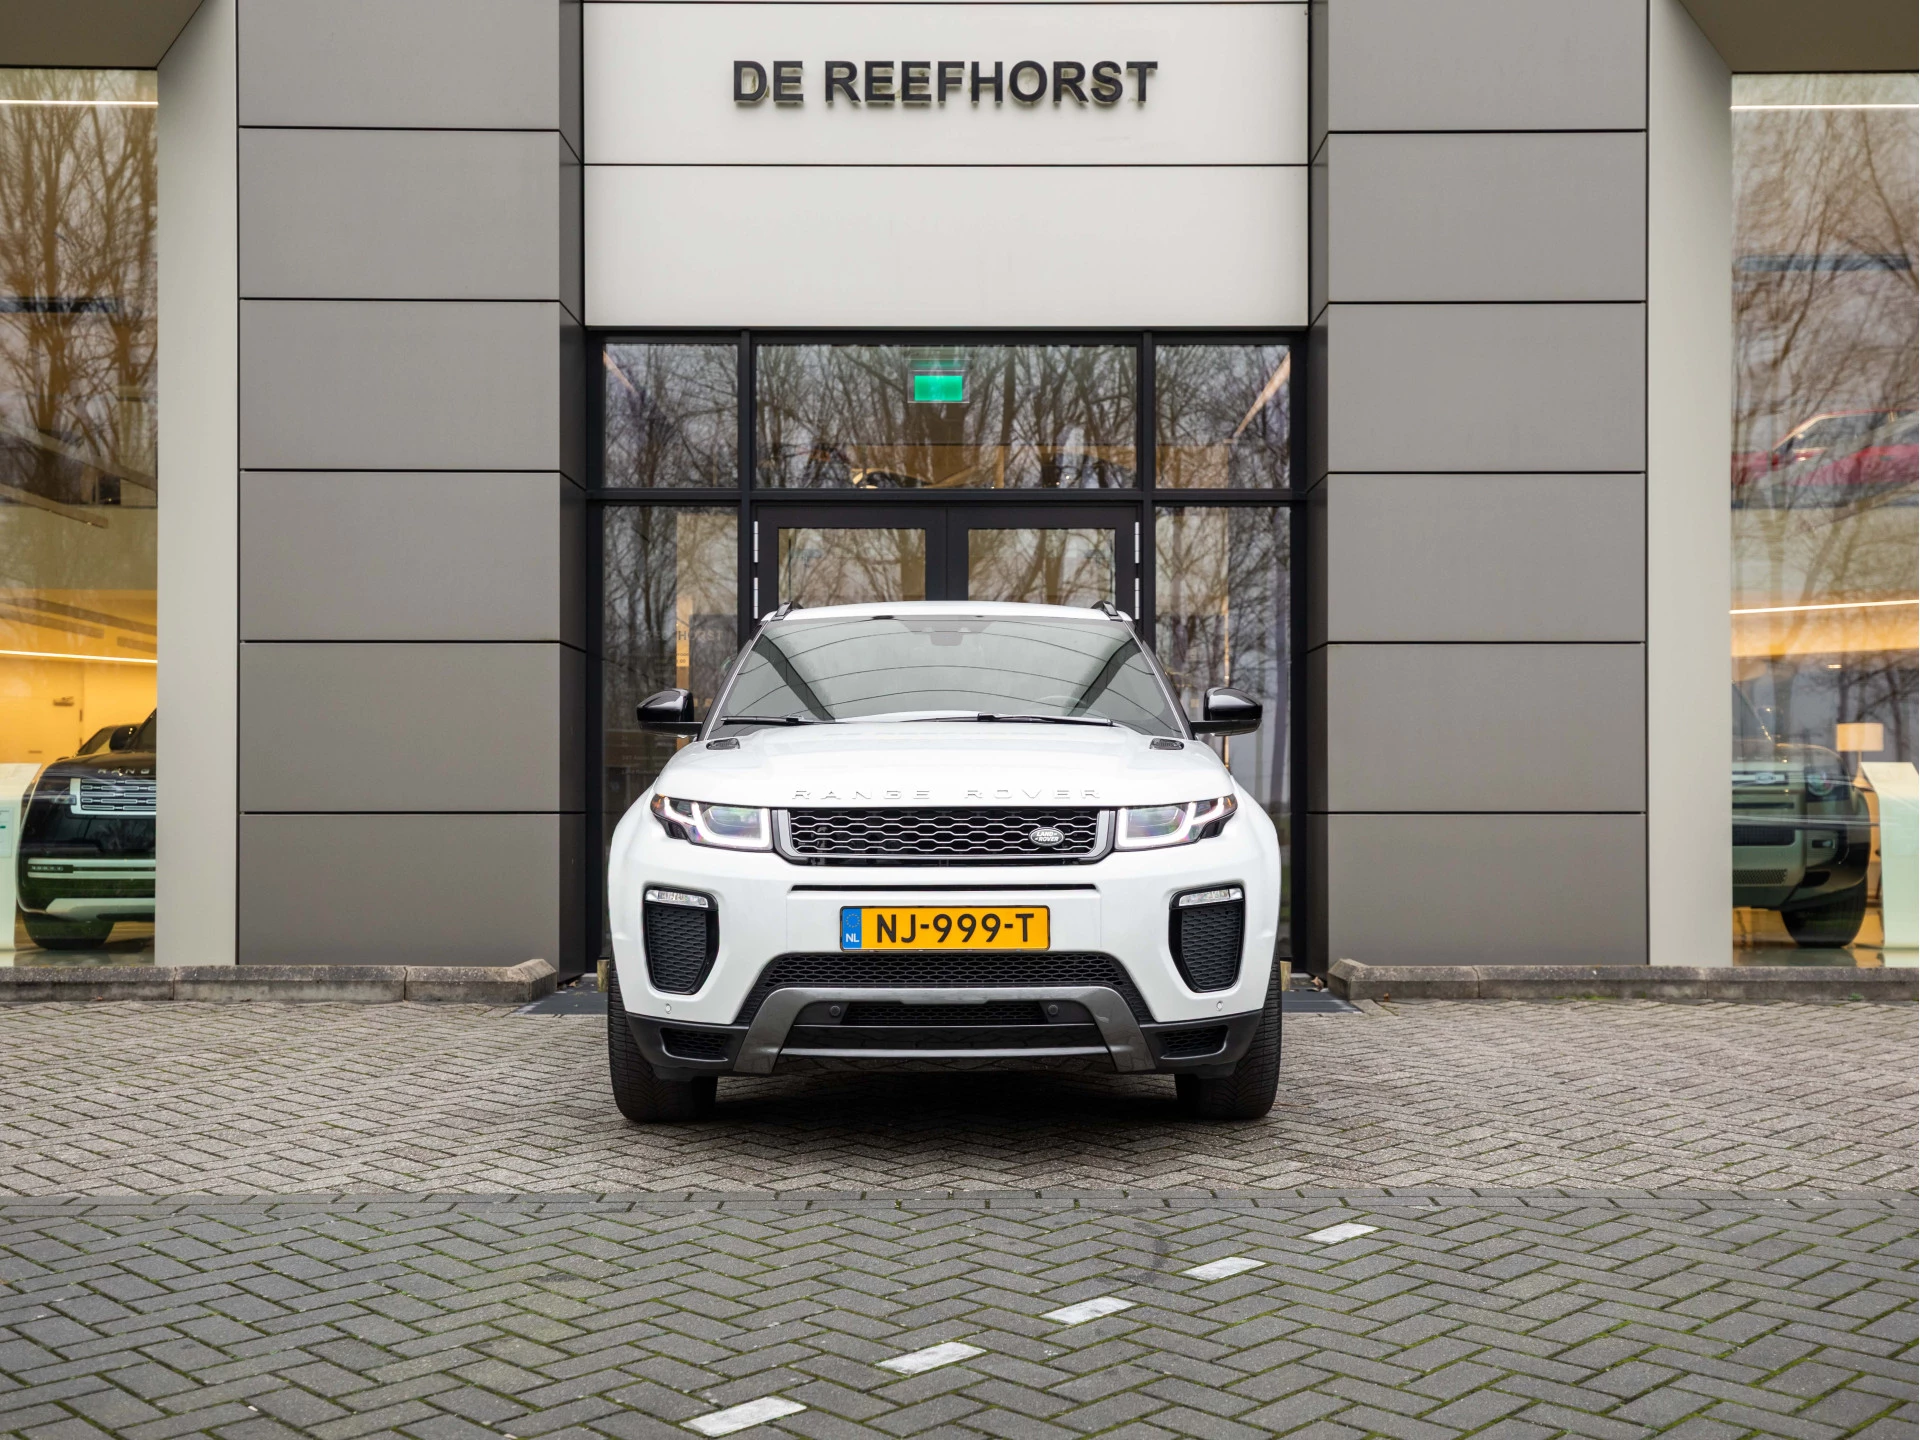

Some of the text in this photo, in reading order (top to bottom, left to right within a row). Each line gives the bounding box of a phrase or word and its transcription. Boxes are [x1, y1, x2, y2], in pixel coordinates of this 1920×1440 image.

[733, 60, 1158, 103] DE REEFHORST
[791, 788, 1100, 800] RANGE ROVER
[845, 933, 860, 943] NL
[877, 913, 1034, 943] NJ-999-T
